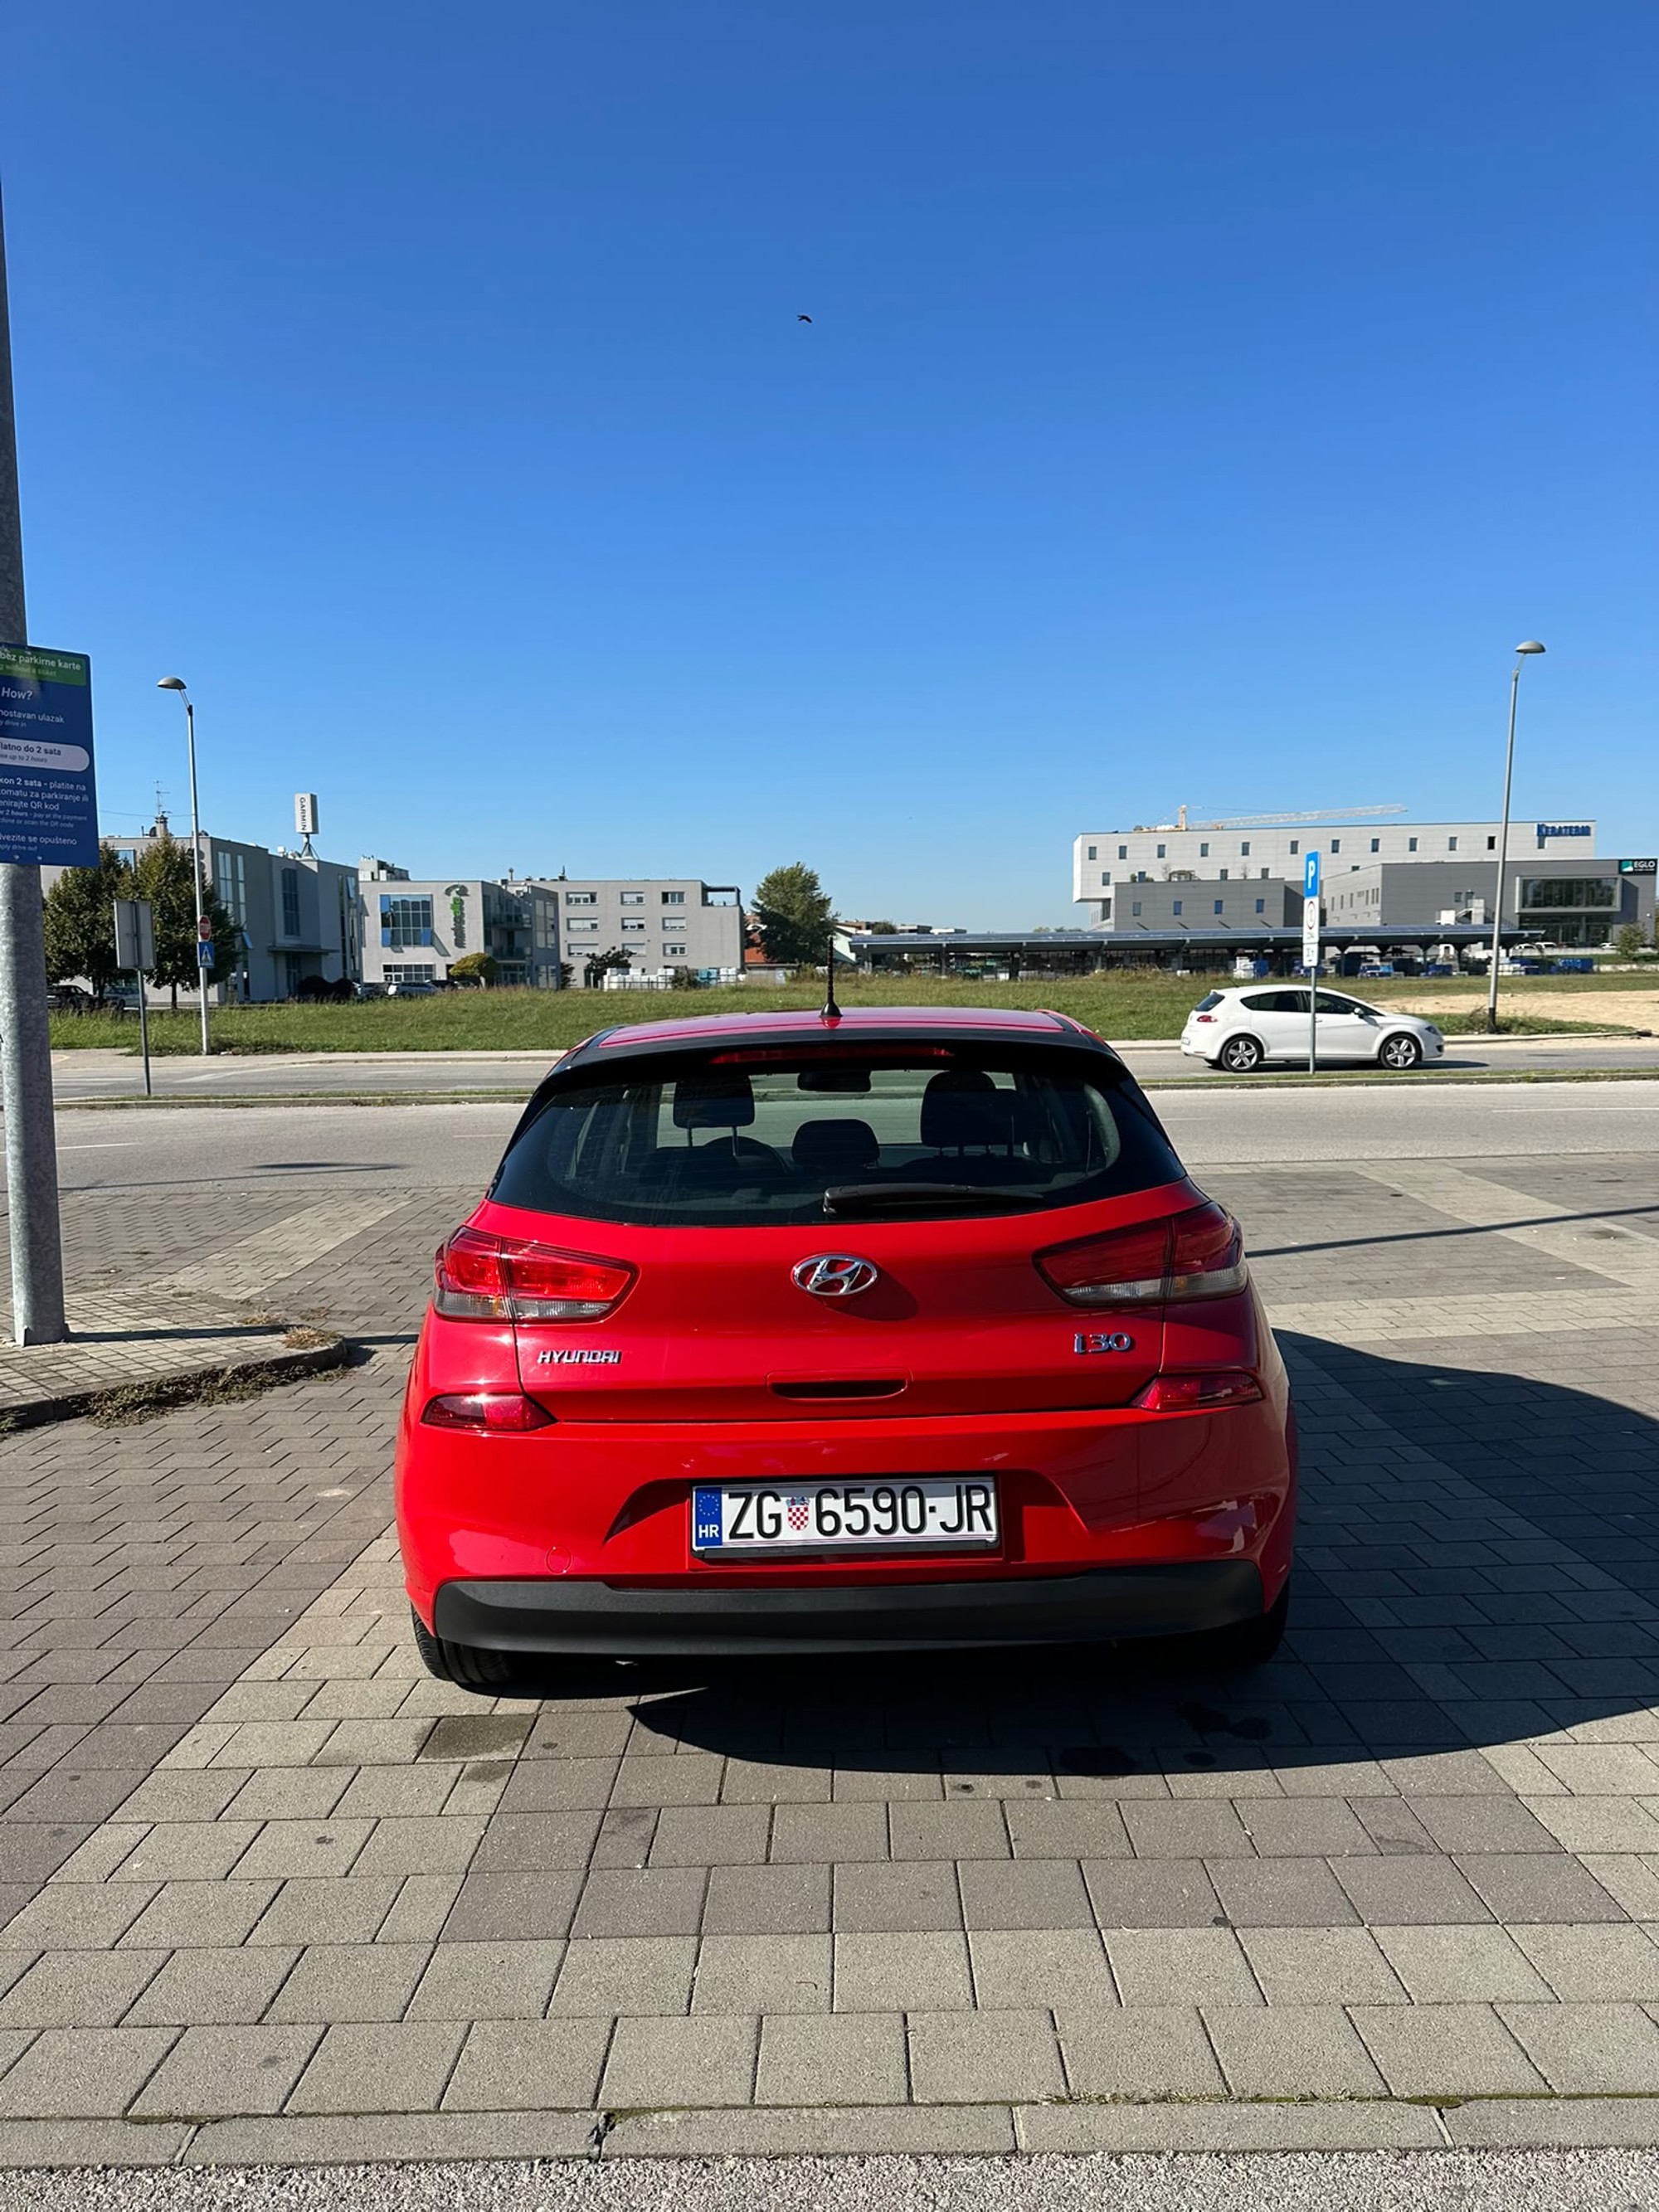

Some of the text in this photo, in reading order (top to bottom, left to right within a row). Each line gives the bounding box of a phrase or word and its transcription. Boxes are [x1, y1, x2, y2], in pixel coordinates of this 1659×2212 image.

[18, 654, 56, 667] parkirne
[57, 659, 81, 670] karte
[2, 687, 32, 700] How?
[38, 713, 65, 723] ulazak
[23, 745, 34, 753] do
[36, 746, 42, 754] 2
[17, 777, 22, 785] 2
[24, 779, 42, 787] sata
[50, 780, 75, 790] platite
[41, 792, 80, 803] parkiranje
[30, 800, 43, 809] QR
[44, 802, 60, 810] kod
[1537, 824, 1591, 837] KERATERM
[39, 835, 78, 845] opušteno
[1633, 860, 1656, 868] EGLO
[1307, 859, 1316, 890] P
[537, 1349, 622, 1364] HYUNDAI
[728, 1490, 782, 1539] ZG
[698, 1524, 719, 1539] HR
